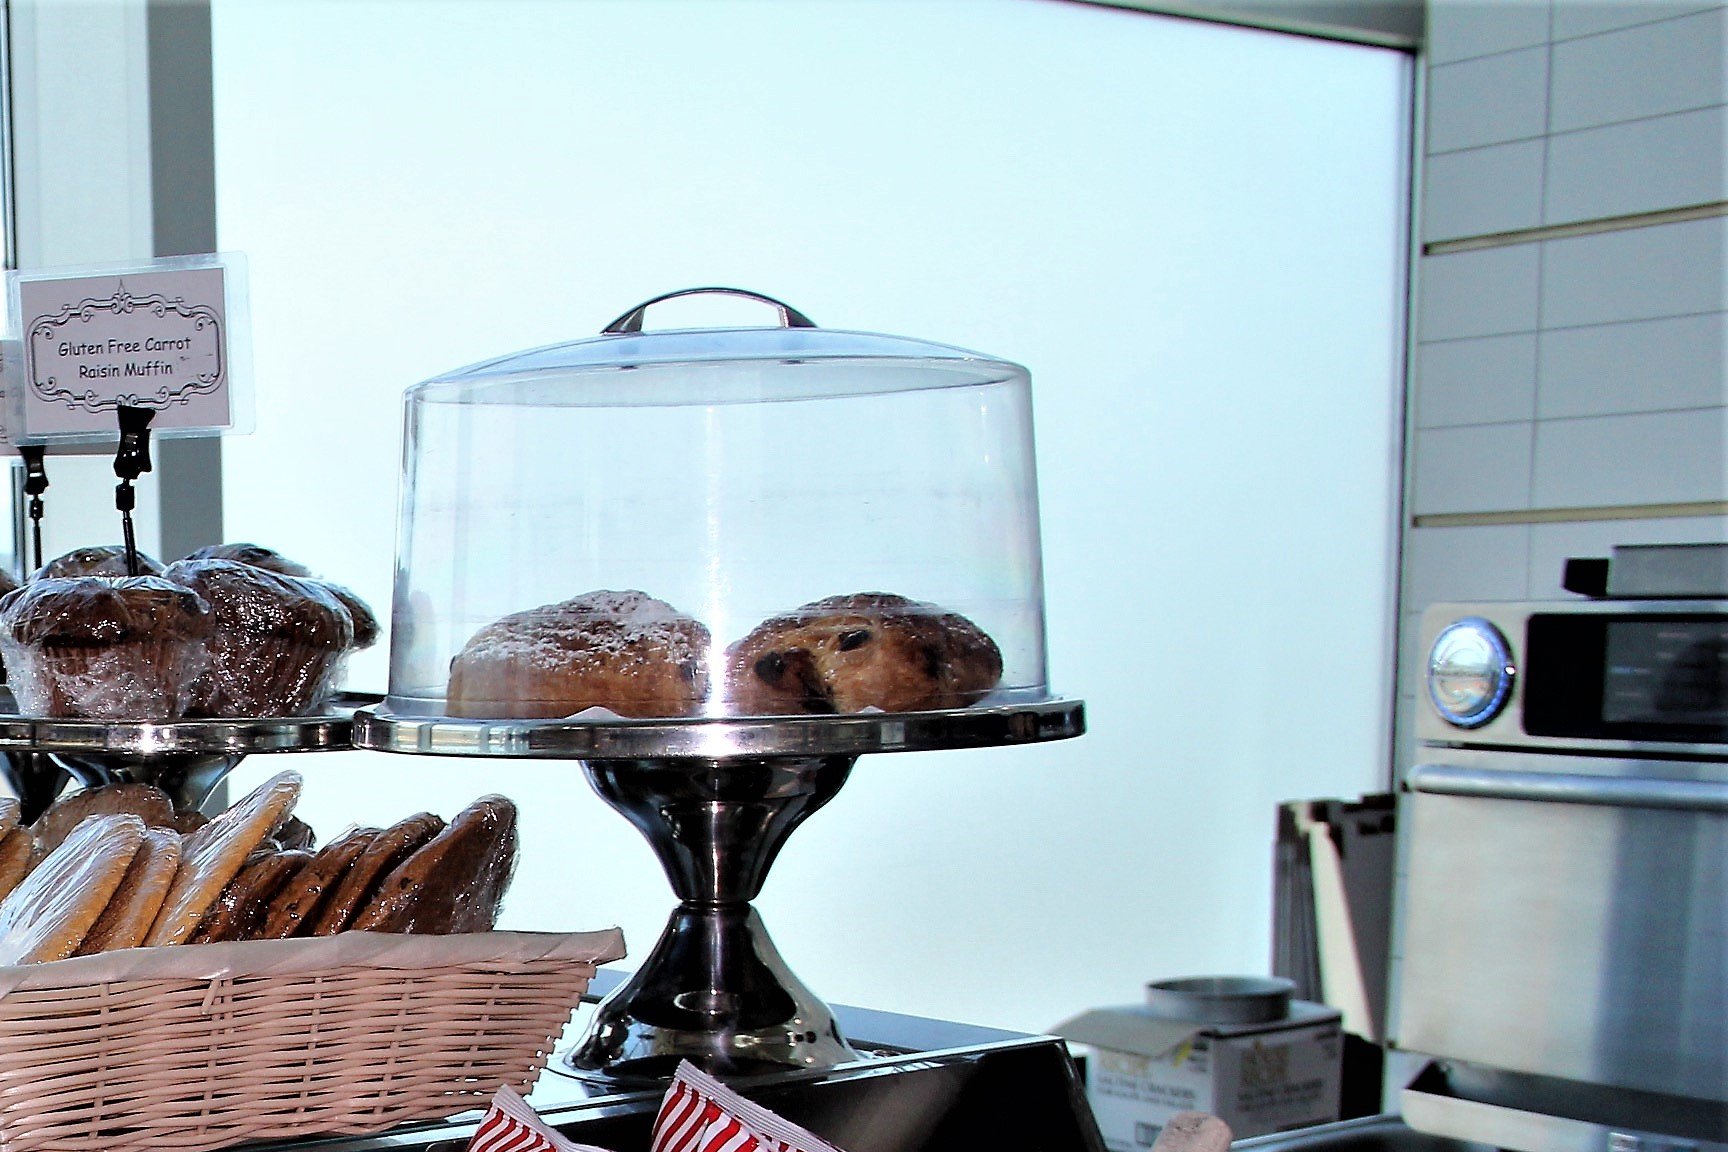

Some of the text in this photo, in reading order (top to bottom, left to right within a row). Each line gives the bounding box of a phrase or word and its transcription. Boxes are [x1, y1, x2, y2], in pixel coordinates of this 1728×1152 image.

[58, 336, 192, 357] Gluten Free Carrot
[78, 363, 173, 379] Raisin Muffin
